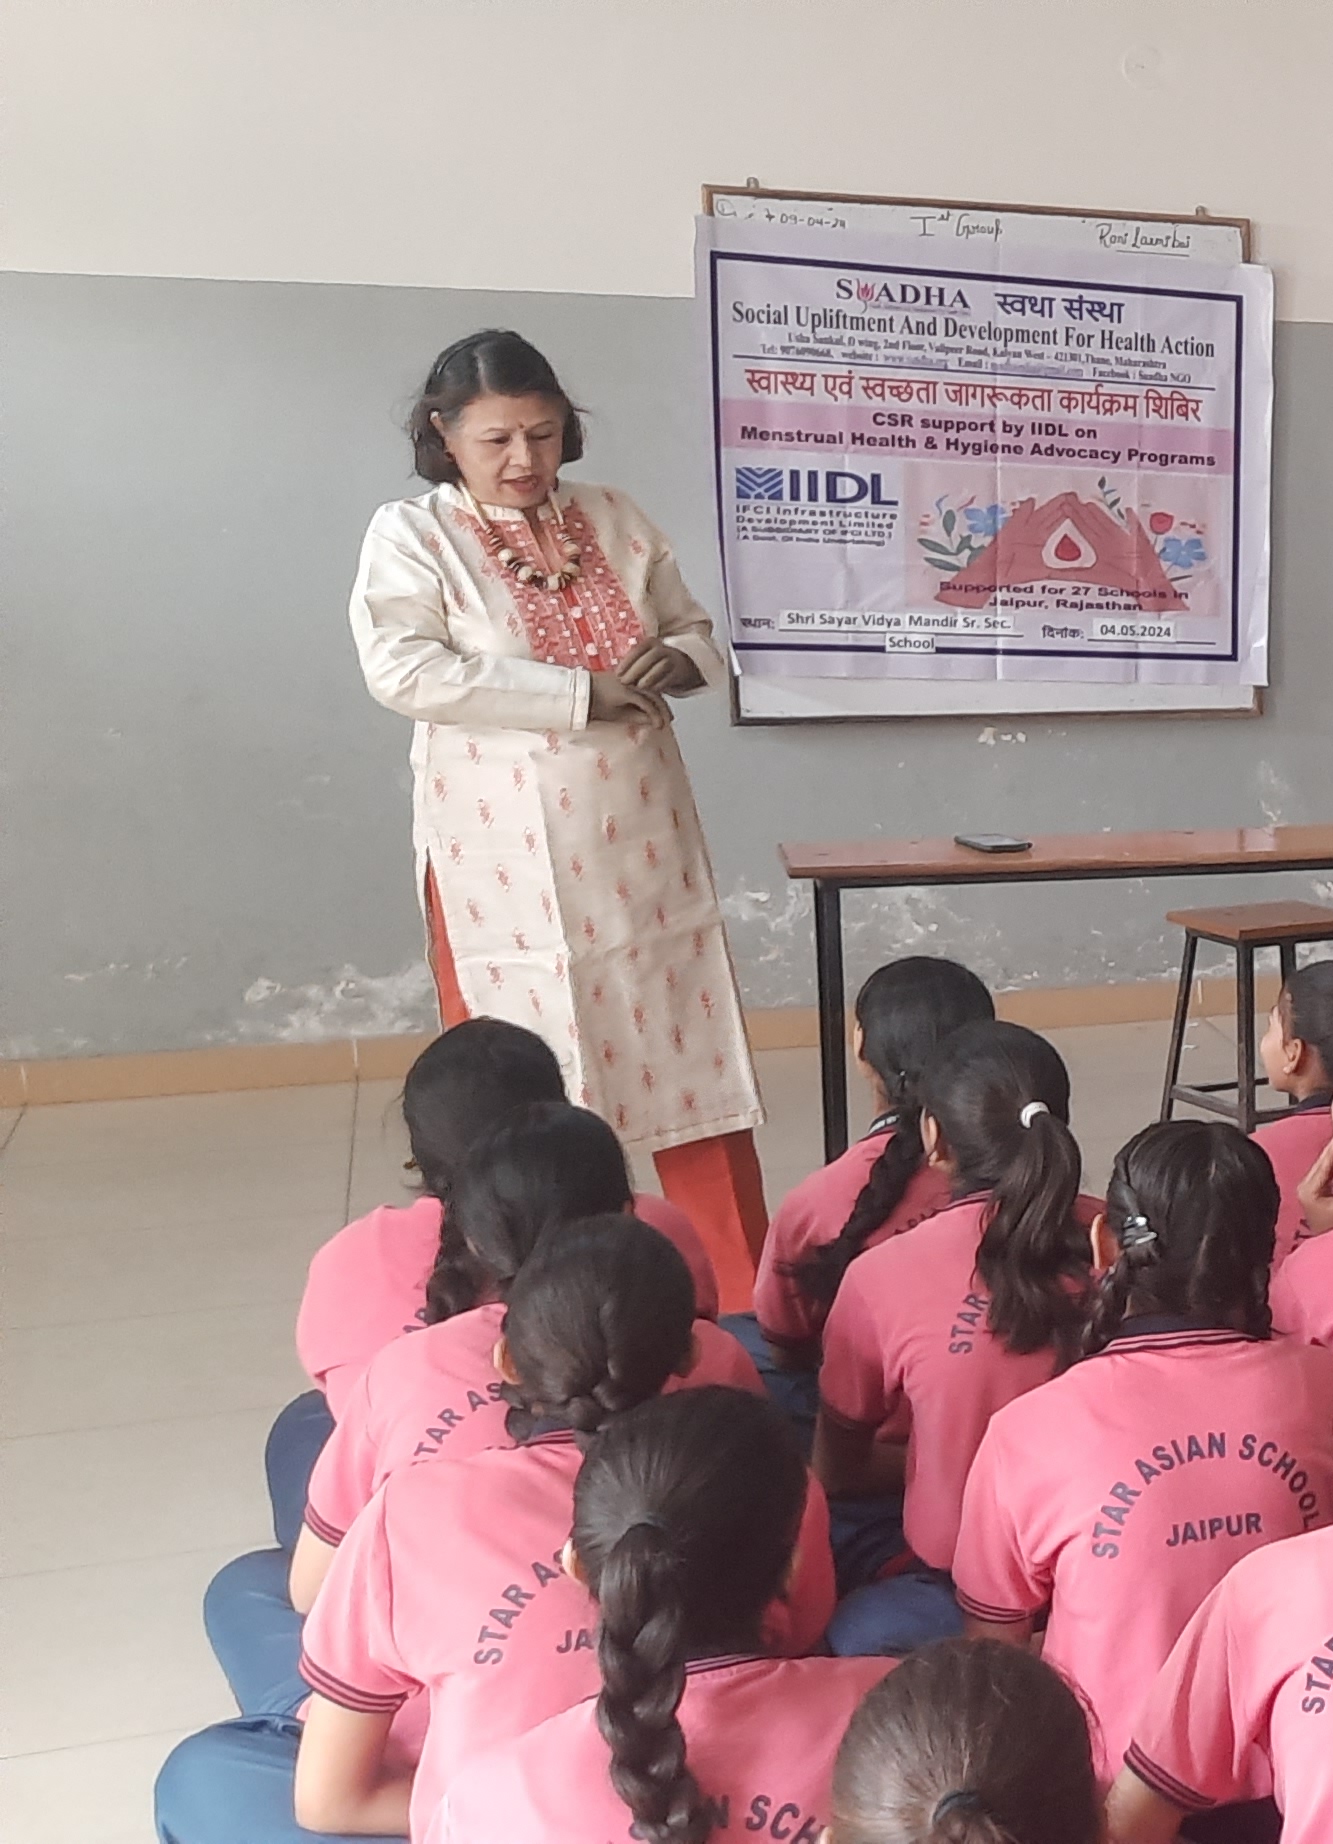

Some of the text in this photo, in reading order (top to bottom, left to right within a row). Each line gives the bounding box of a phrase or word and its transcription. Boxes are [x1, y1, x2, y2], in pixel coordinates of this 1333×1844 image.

[994, 293, 1056, 319] स्वधा
[1062, 294, 1126, 325] संस्था
[732, 301, 1216, 358] Social Upliftment And Development For Health Action
[745, 368, 1203, 422] स्वास्थ्य एवं स्वच्छता जागरूकता कार्यक्रम शिबिर
[872, 412, 1098, 439] CSR support by IIDL on
[740, 425, 1217, 467] Menstrual Health & Hygiene Advocacy Programs
[789, 469, 899, 506] IIDL
[735, 515, 894, 530] Development Limited
[776, 506, 898, 520] Infrastructure
[940, 581, 1034, 594] Supported
[1040, 584, 1067, 595] for
[1070, 585, 1092, 596] 27
[1098, 587, 1168, 600] Schools
[1055, 599, 1144, 612] Rajasthan
[787, 612, 1012, 630] Shri Sayar Vidya Mandir Sr. Sec.
[1100, 624, 1172, 638] 04.05.2024
[888, 637, 936, 650] School
[949, 1293, 990, 1354] STAR
[411, 1408, 465, 1465] TAR
[1091, 1432, 1320, 1560] STAR ASIAN SCHOOL
[1166, 1512, 1263, 1547] JAIPUR
[473, 1583, 537, 1666] STAR
